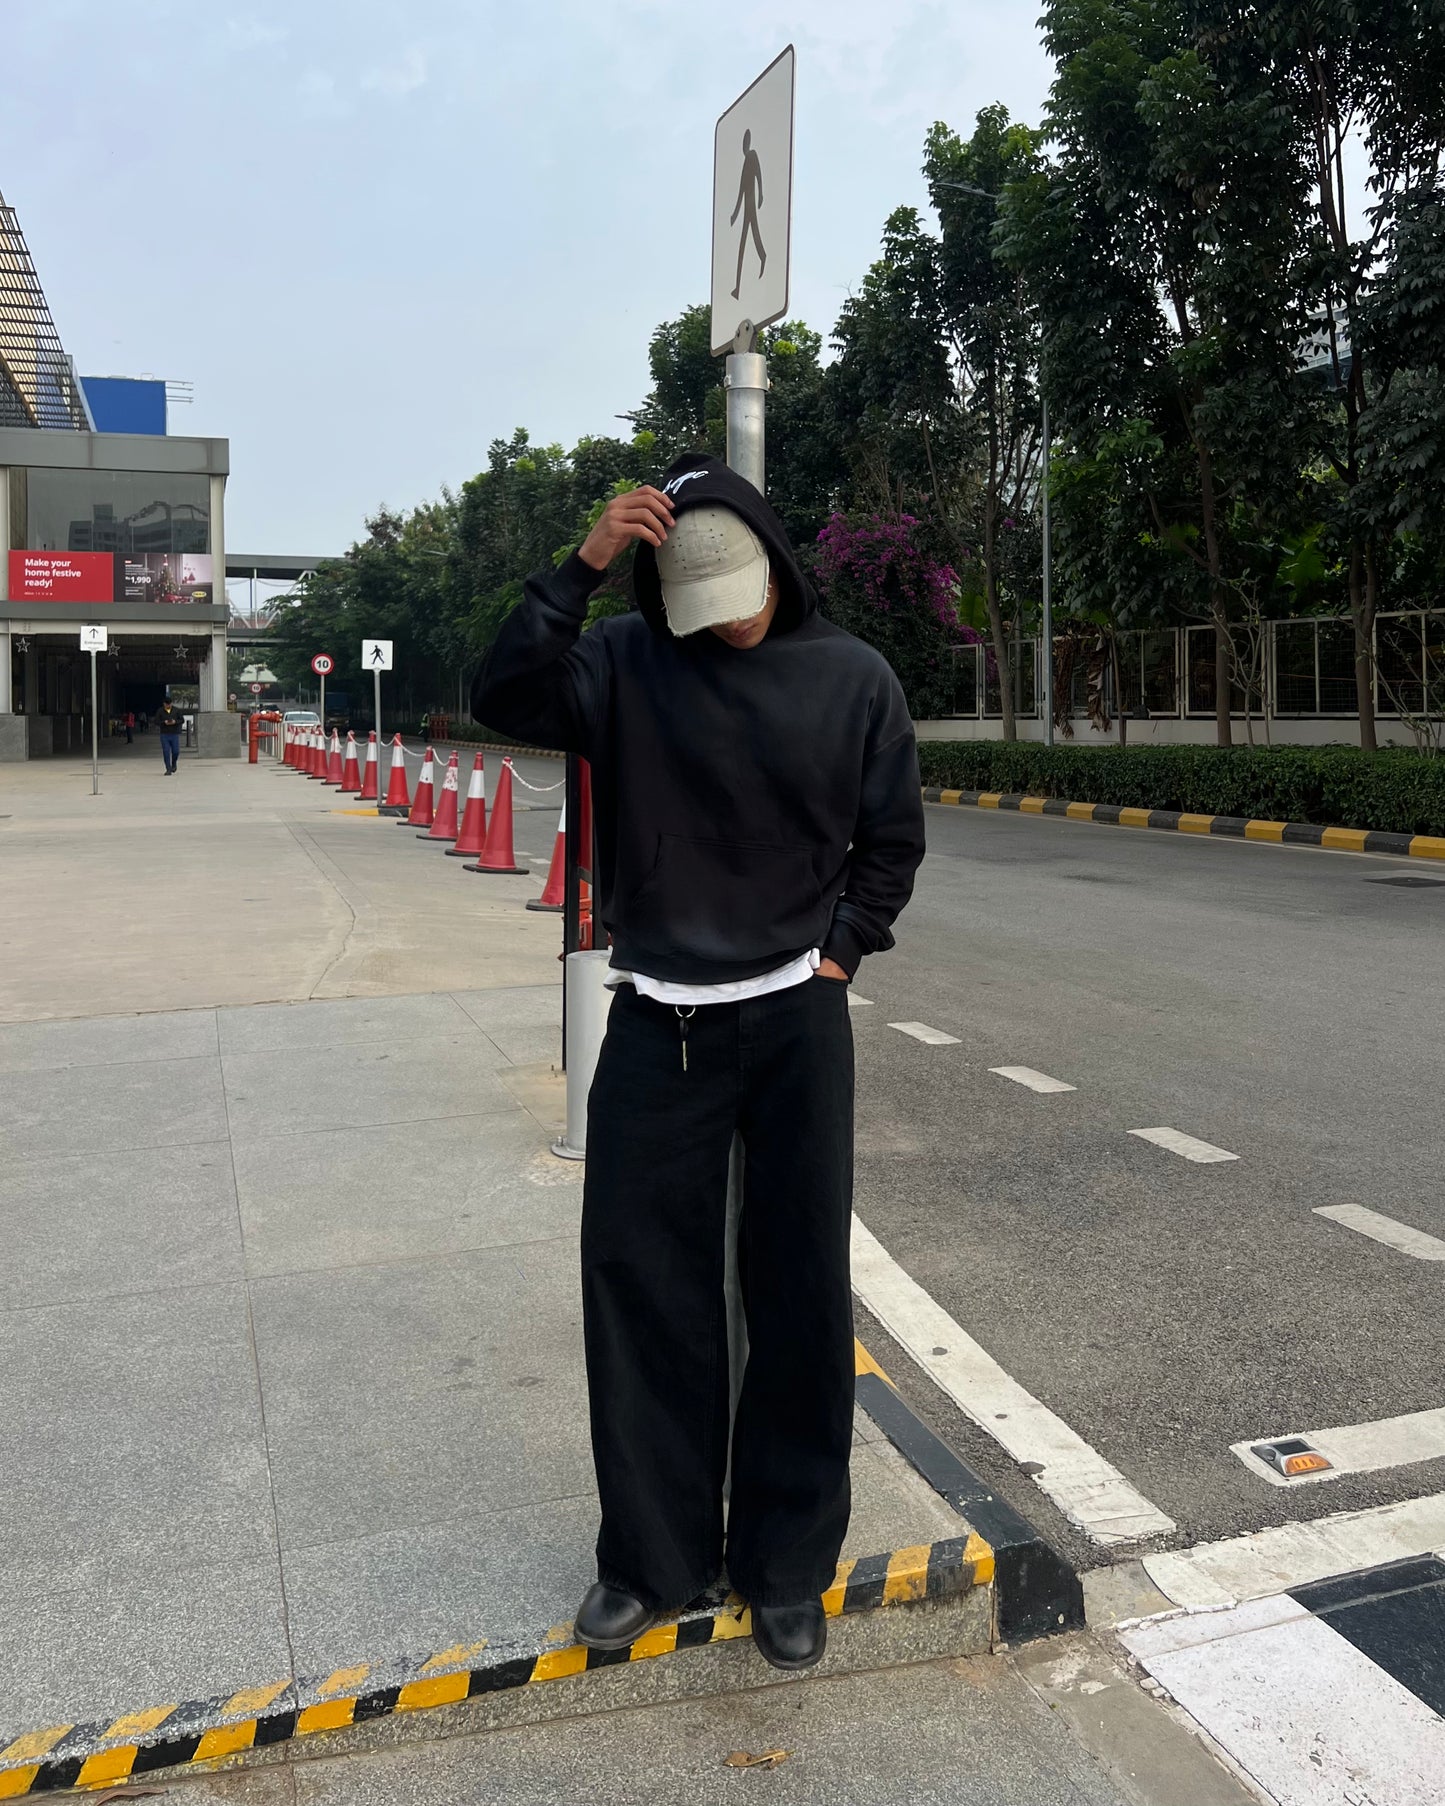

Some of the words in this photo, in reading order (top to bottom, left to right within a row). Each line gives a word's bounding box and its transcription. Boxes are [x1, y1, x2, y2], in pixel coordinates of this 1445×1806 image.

[24, 558, 49, 567] Make
[51, 560, 71, 569] your
[24, 568, 50, 577] home
[52, 569, 81, 578] festive
[24, 579, 53, 588] ready!
[131, 576, 151, 584] 1,990
[316, 659, 329, 669] 10
